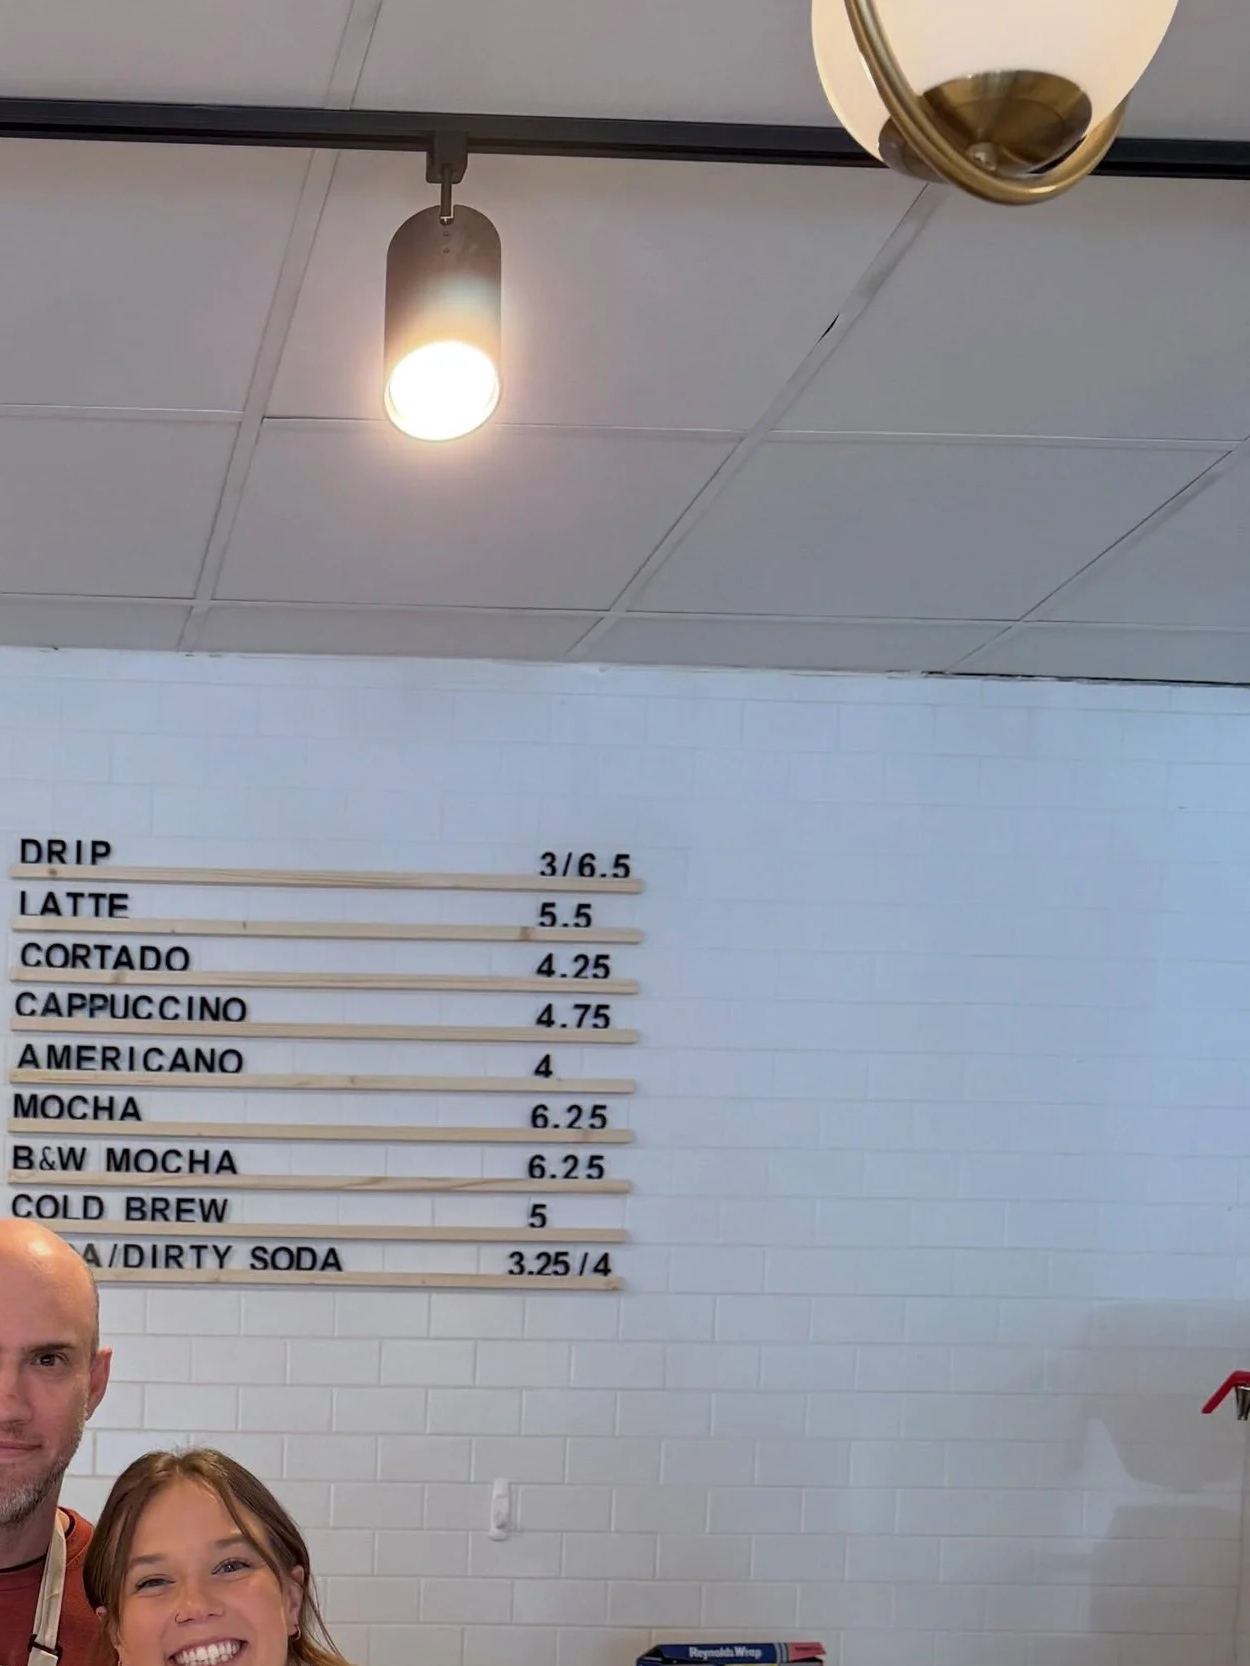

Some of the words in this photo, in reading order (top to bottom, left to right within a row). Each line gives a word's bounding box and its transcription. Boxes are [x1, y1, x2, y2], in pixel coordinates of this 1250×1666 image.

[20, 838, 112, 866] DRIP
[539, 852, 630, 878] 3/6.5
[20, 891, 129, 918] LATTE
[538, 902, 591, 928] 5.5
[20, 942, 190, 972] CORTADO
[536, 953, 610, 979] 4.25
[15, 992, 247, 1022] CAPPUCCINO
[536, 1003, 610, 1029] 4.75
[17, 1043, 244, 1074] AMERICANO
[534, 1054, 553, 1079] 4
[13, 1093, 142, 1121] MOCHA
[531, 1104, 607, 1129] 6.25
[13, 1145, 86, 1171] B&W
[106, 1148, 238, 1174] MOCHA
[528, 1154, 605, 1179] 6.25
[11, 1193, 105, 1220] COLD
[125, 1197, 228, 1223] BREW
[528, 1203, 547, 1228] 5
[69, 1243, 232, 1269] A/DIRTY
[250, 1247, 342, 1272] SODA
[689, 1647, 735, 1660] Reynolds
[735, 1647, 762, 1660] Wrap
